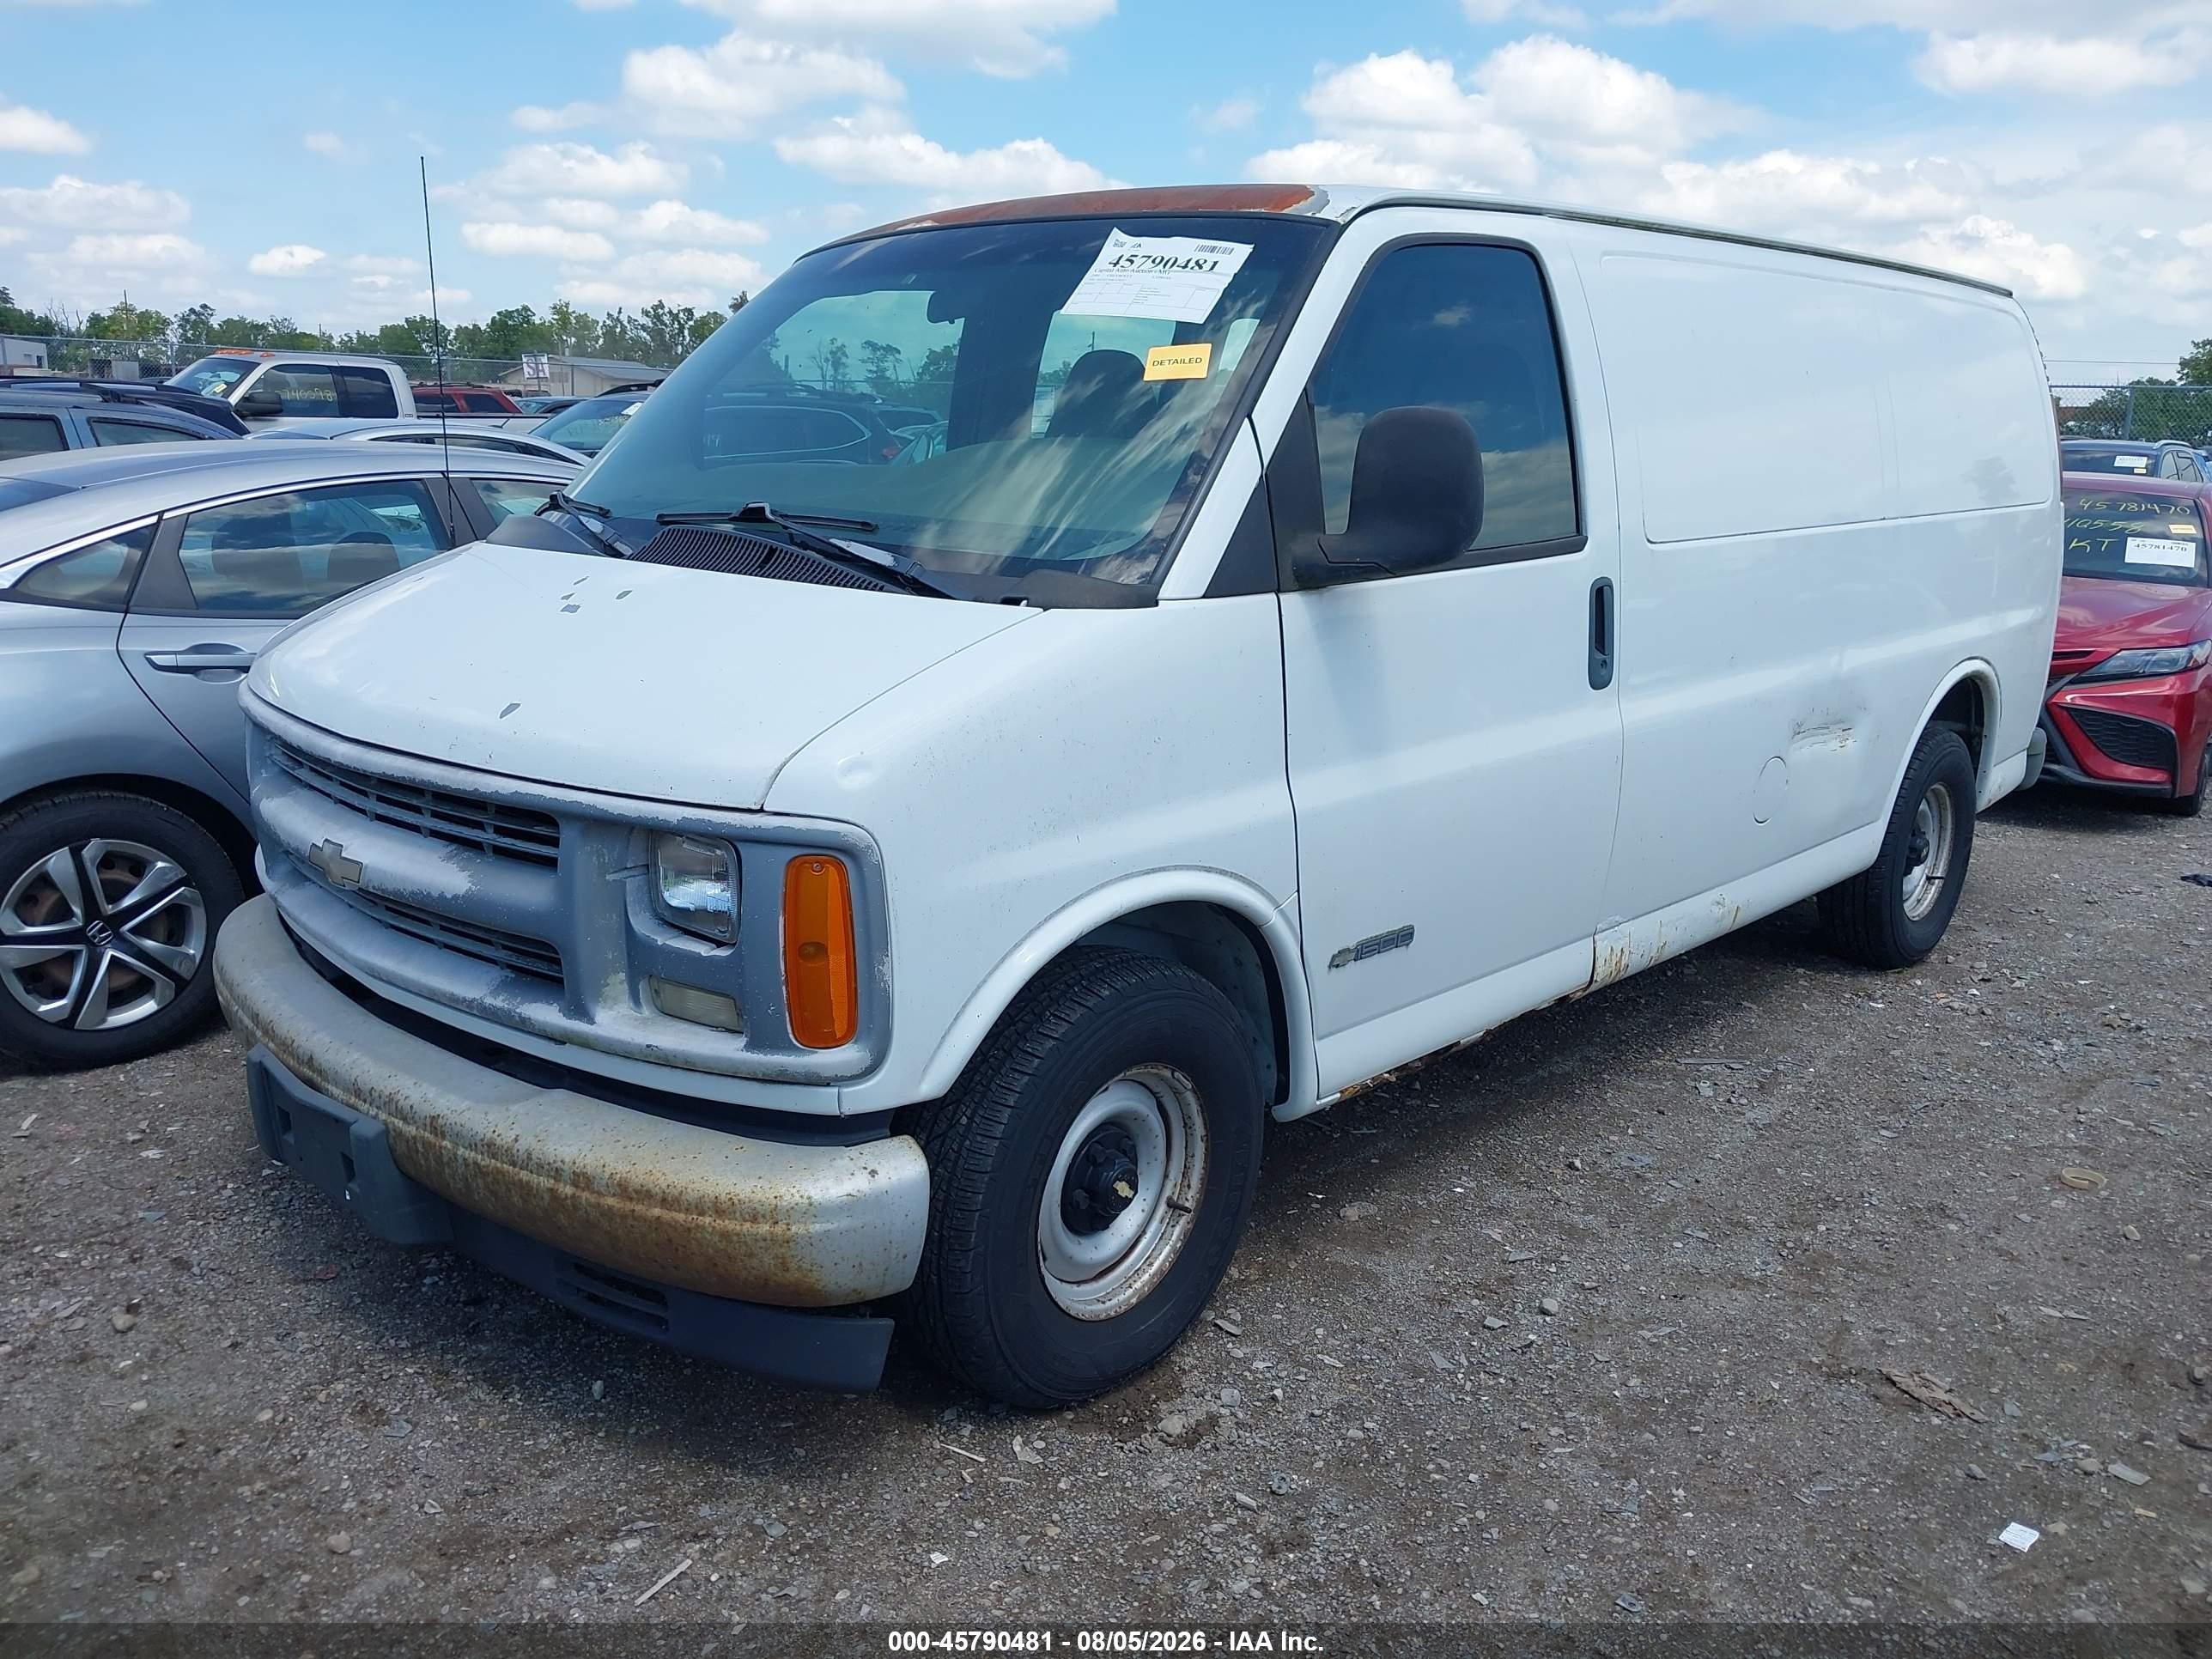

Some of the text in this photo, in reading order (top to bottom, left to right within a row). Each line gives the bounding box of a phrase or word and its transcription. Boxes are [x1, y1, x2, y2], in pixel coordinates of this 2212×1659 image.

[1108, 253, 1219, 272] 45790481
[1152, 356, 1203, 368] DETAILED
[1354, 927, 1414, 961] 1500
